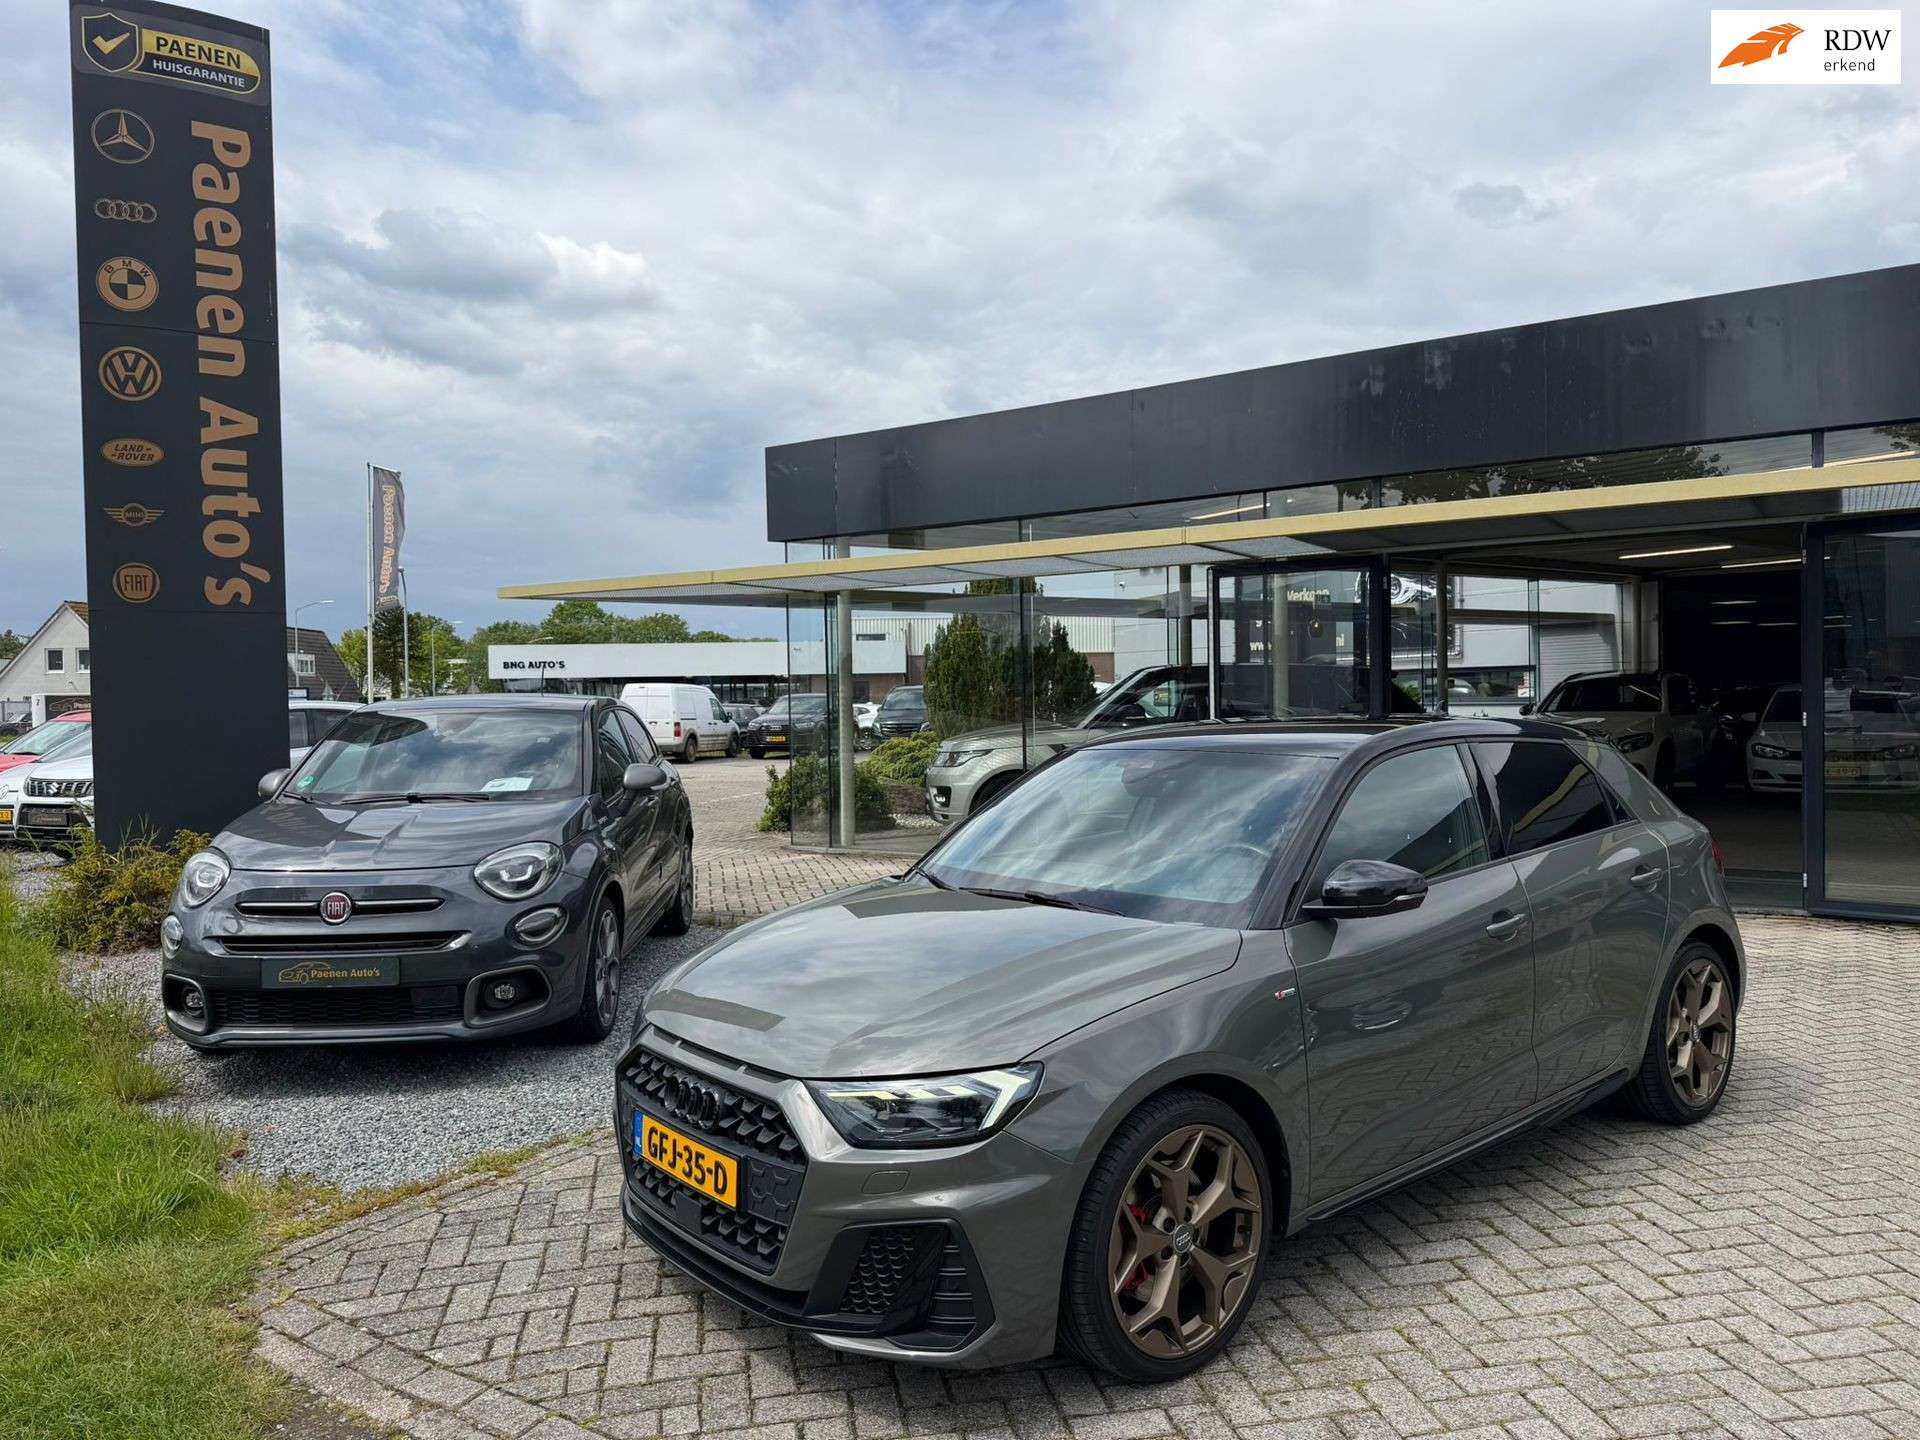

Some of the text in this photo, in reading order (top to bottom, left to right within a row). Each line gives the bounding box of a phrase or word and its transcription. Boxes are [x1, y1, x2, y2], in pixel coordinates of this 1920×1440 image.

[155, 36, 241, 70] PAENEN
[152, 59, 246, 88] HUISGARANTIE
[191, 120, 271, 607] Paenen Auto's
[124, 574, 148, 592] FIAT
[503, 661, 566, 669] BNG AUTO'S
[327, 901, 345, 915] FIAT
[311, 967, 380, 978] Paenen Auto's
[647, 1125, 729, 1196] GFJ-35-D
